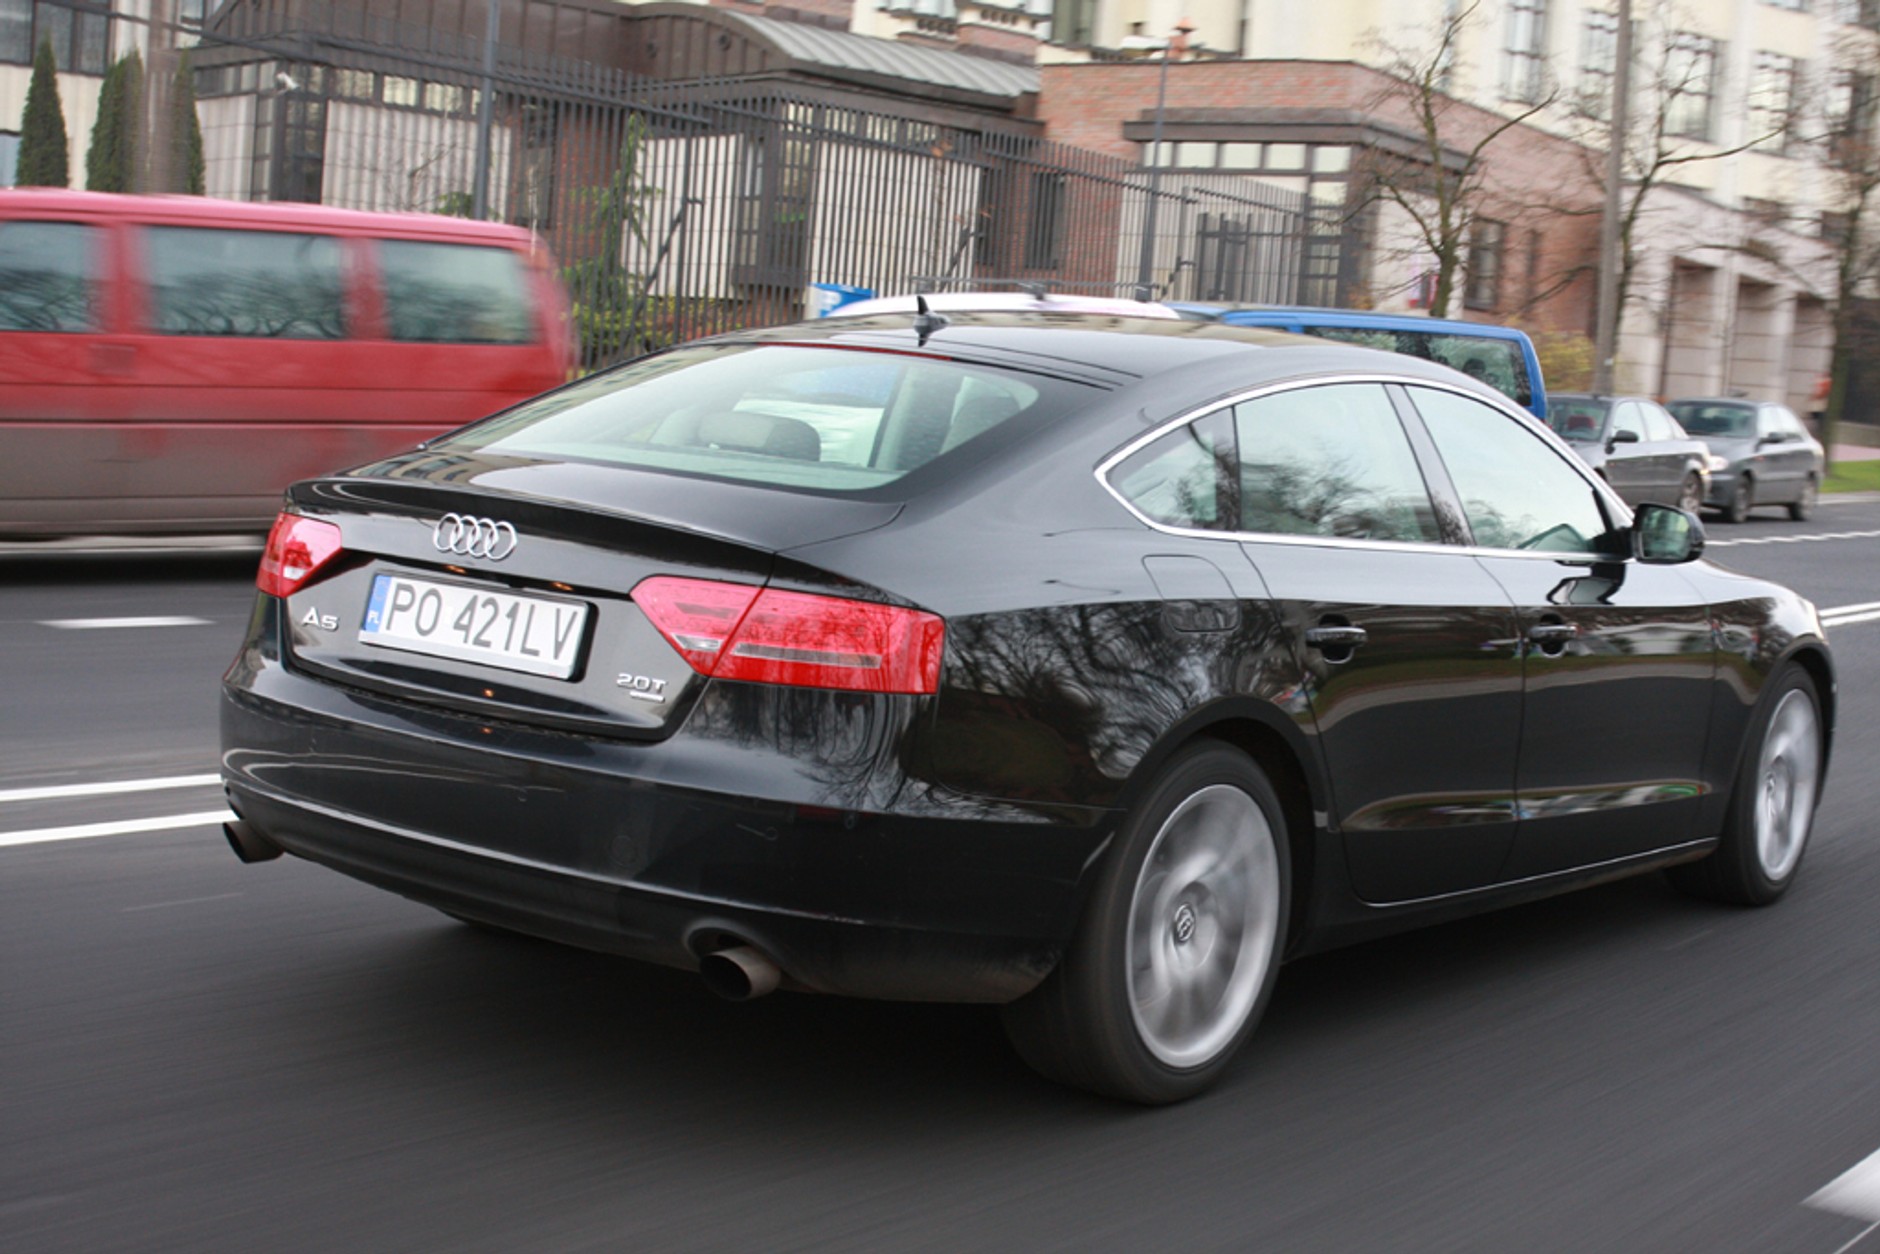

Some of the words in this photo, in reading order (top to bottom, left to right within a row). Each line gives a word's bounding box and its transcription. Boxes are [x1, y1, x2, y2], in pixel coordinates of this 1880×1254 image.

[302, 606, 338, 630] A5
[385, 583, 443, 637] PO
[453, 594, 578, 660] 421LV
